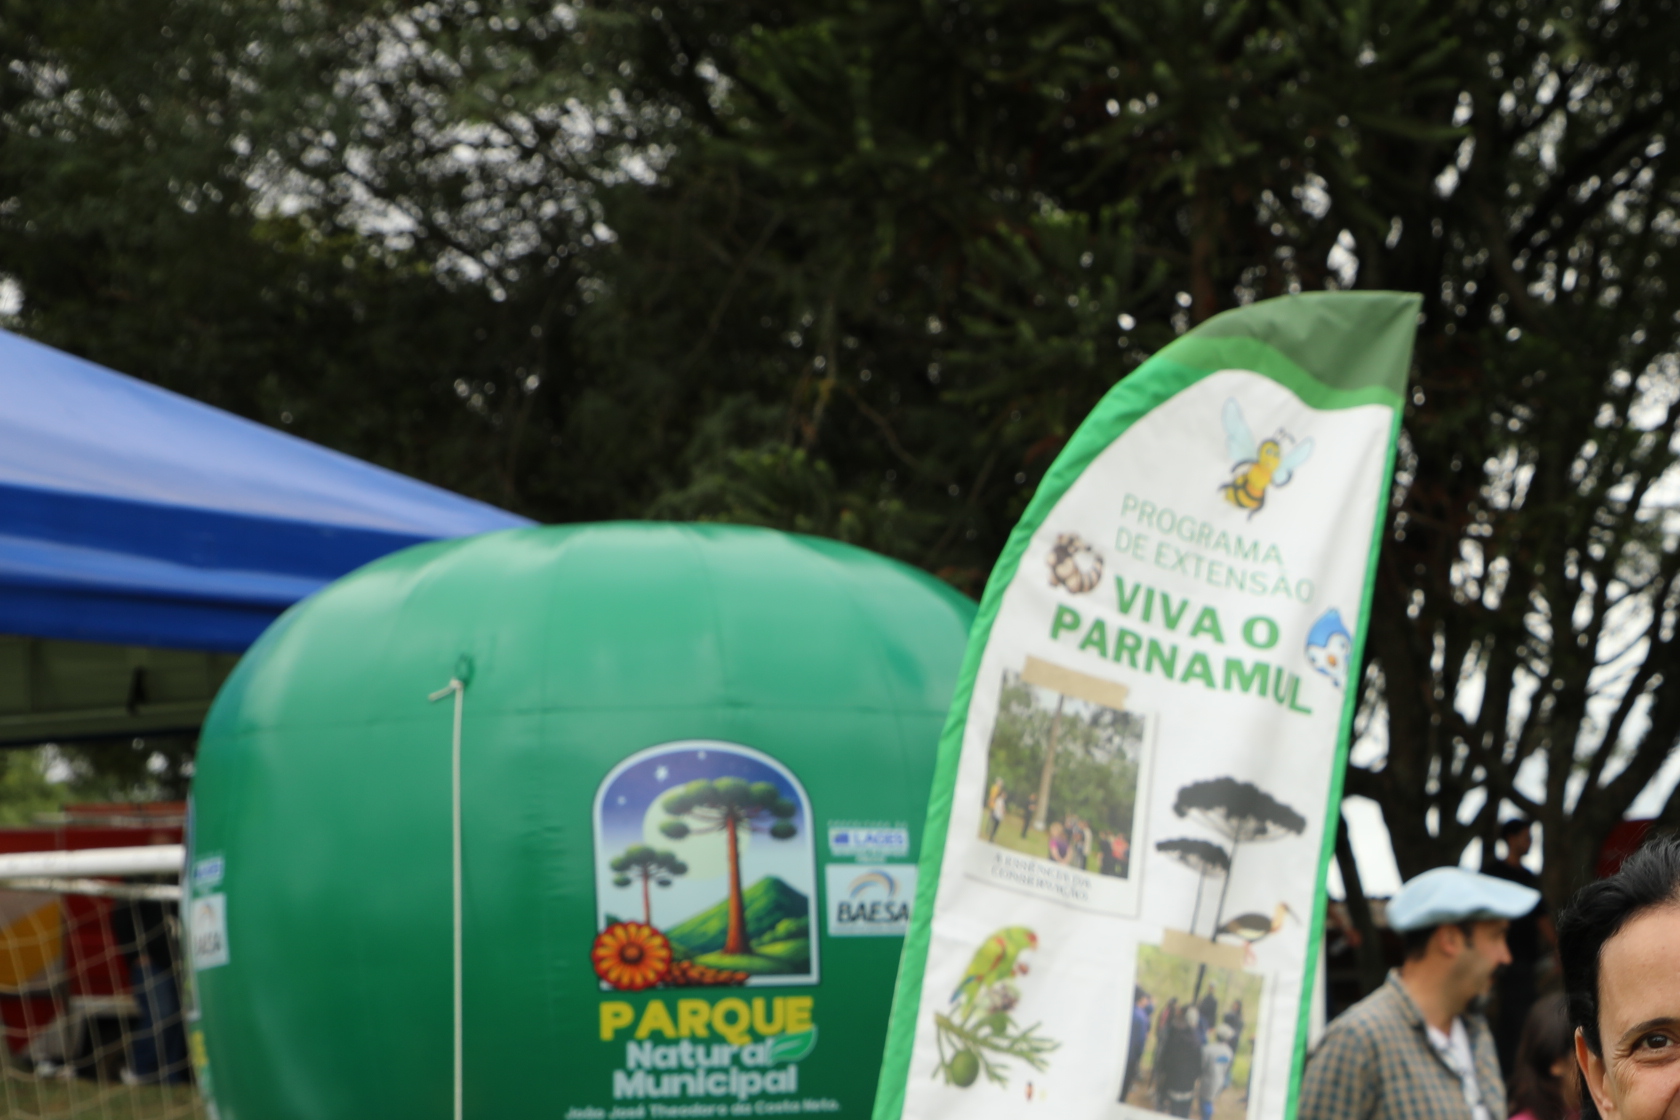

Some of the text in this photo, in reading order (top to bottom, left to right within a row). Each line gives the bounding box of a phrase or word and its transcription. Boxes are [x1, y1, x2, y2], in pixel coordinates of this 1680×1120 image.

[1121, 493, 1285, 567] PROGRAMA
[1115, 527, 1317, 605] DE EXTENSÃO
[1114, 575, 1281, 651] VIVA O
[1049, 603, 1314, 716] PARNAMUL
[837, 901, 910, 922] BAESA
[600, 996, 815, 1046] PARQUE
[613, 1064, 798, 1102] Municipal
[626, 1038, 776, 1071] Natural
